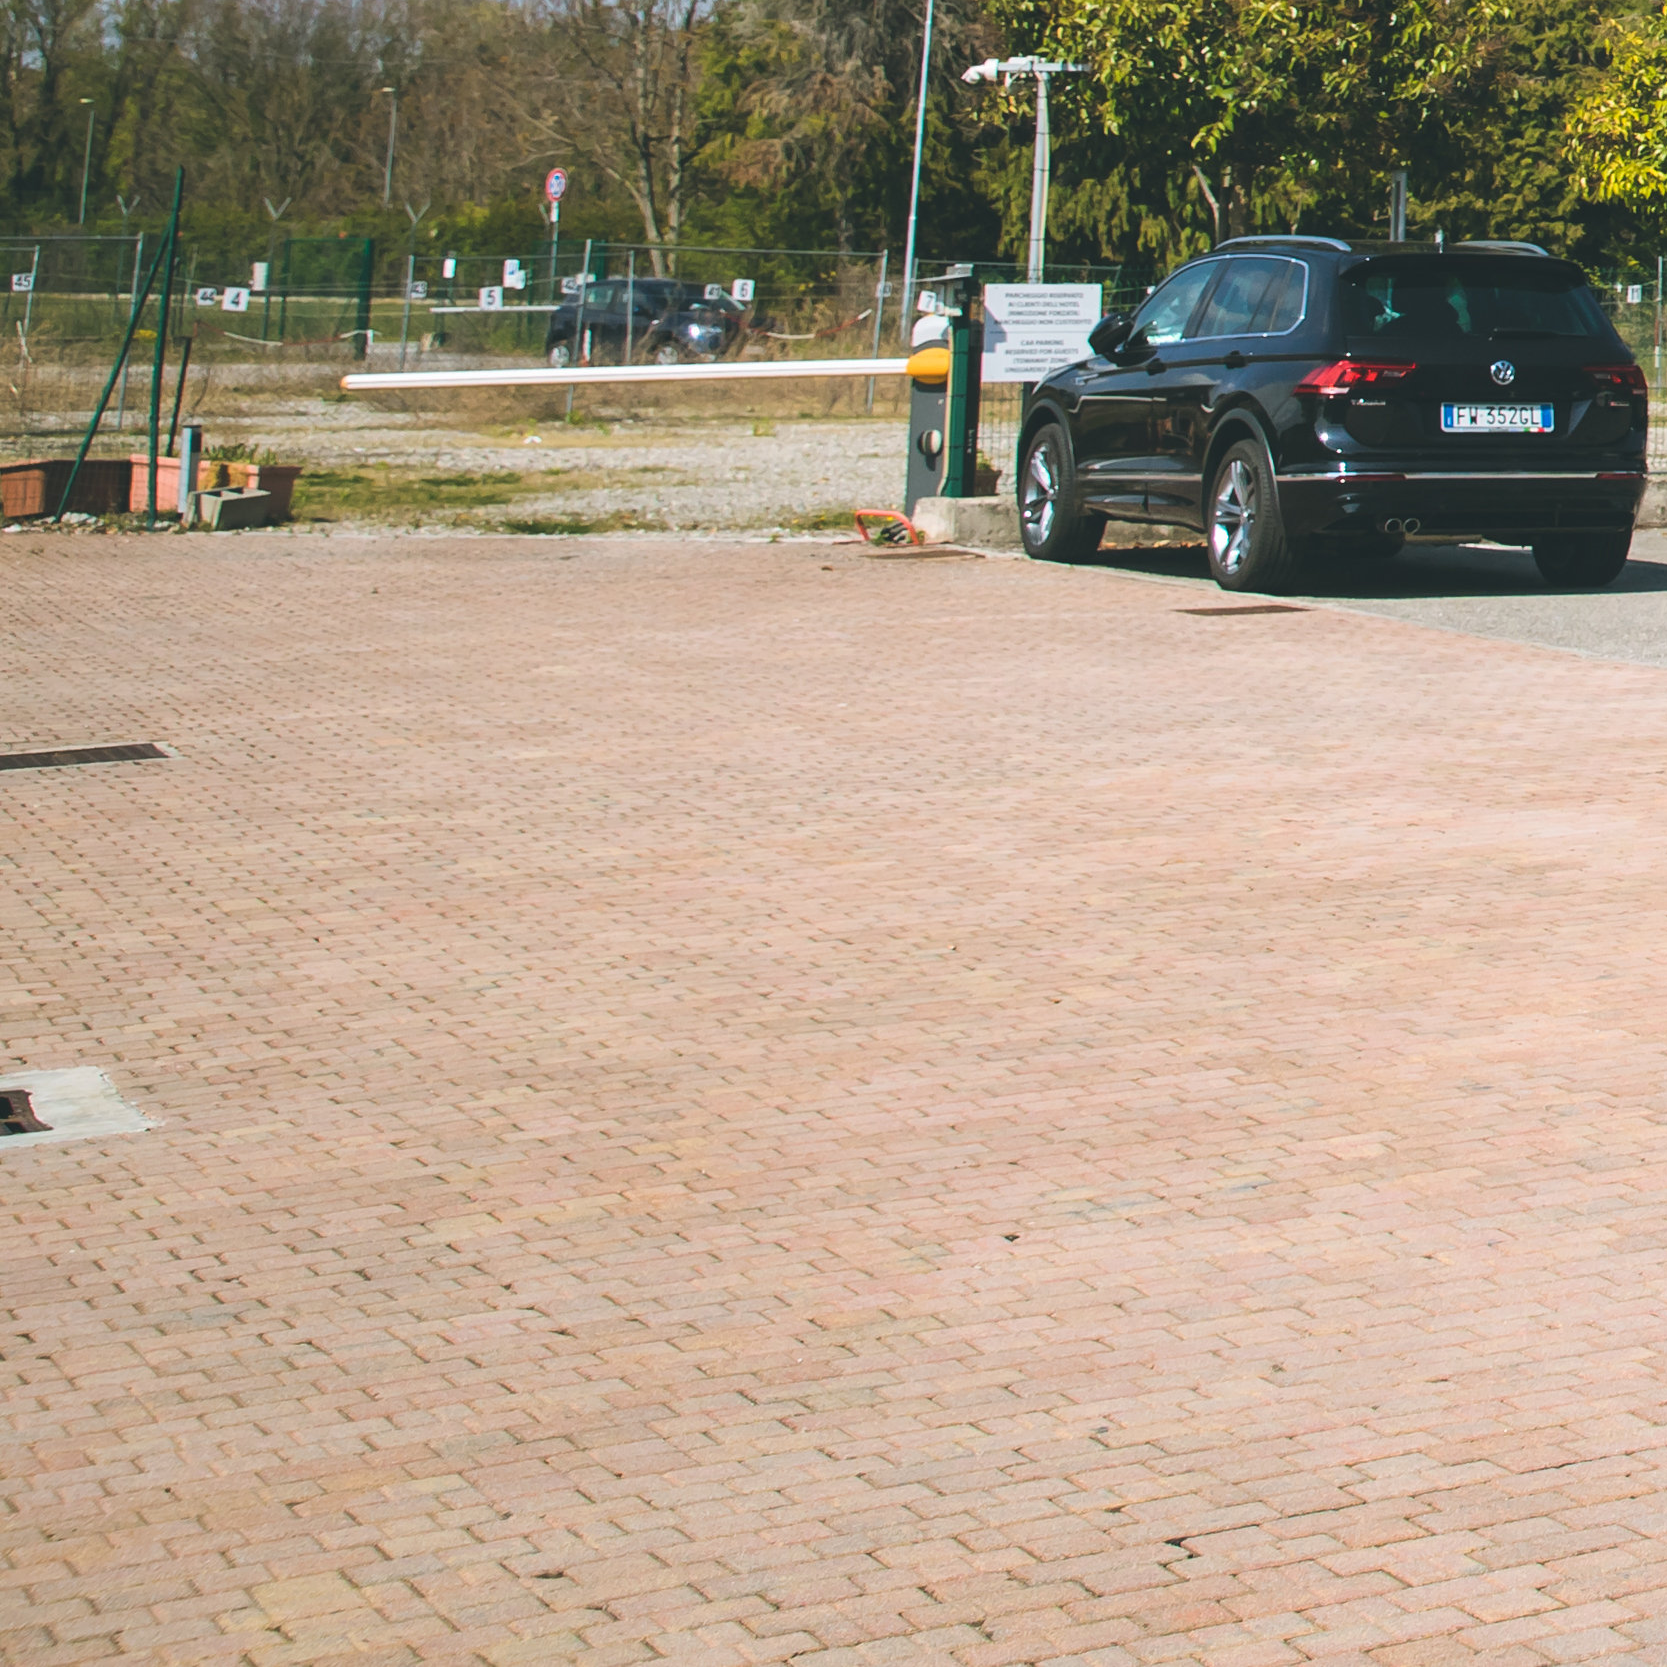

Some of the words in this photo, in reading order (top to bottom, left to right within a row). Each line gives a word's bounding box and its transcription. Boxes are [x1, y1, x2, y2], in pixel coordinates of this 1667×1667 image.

[487, 289, 496, 305] 5
[740, 282, 749, 298] 6
[230, 291, 241, 307] 4
[925, 294, 934, 309] 7
[1485, 406, 1540, 425] 352GL
